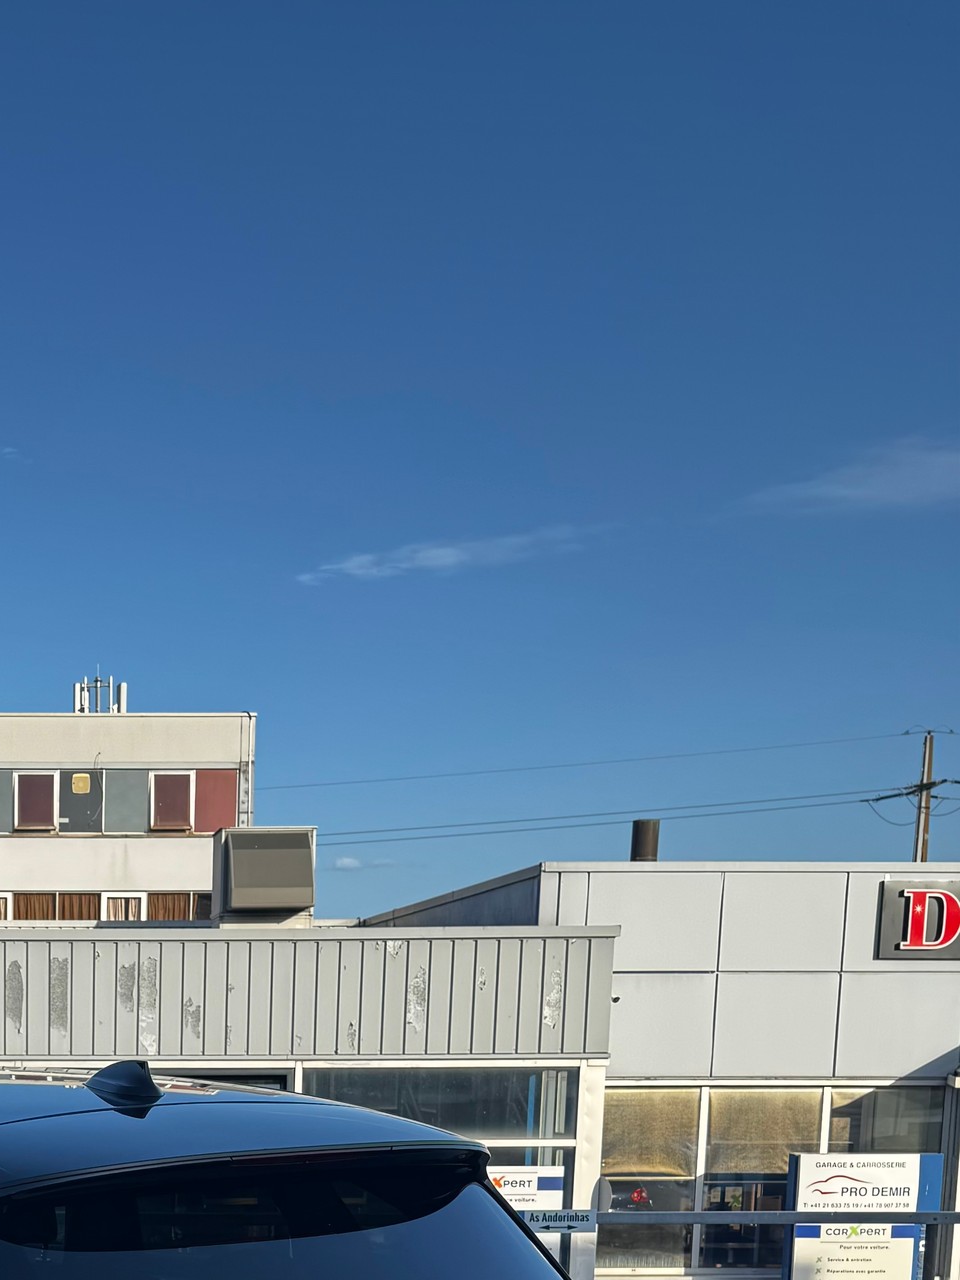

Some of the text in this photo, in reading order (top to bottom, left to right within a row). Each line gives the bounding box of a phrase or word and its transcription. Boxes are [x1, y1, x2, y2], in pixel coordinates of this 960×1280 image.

[900, 889, 960, 950] D
[841, 1187, 911, 1197] PRO DEMIR
[529, 1212, 590, 1223] As Andorinhas
